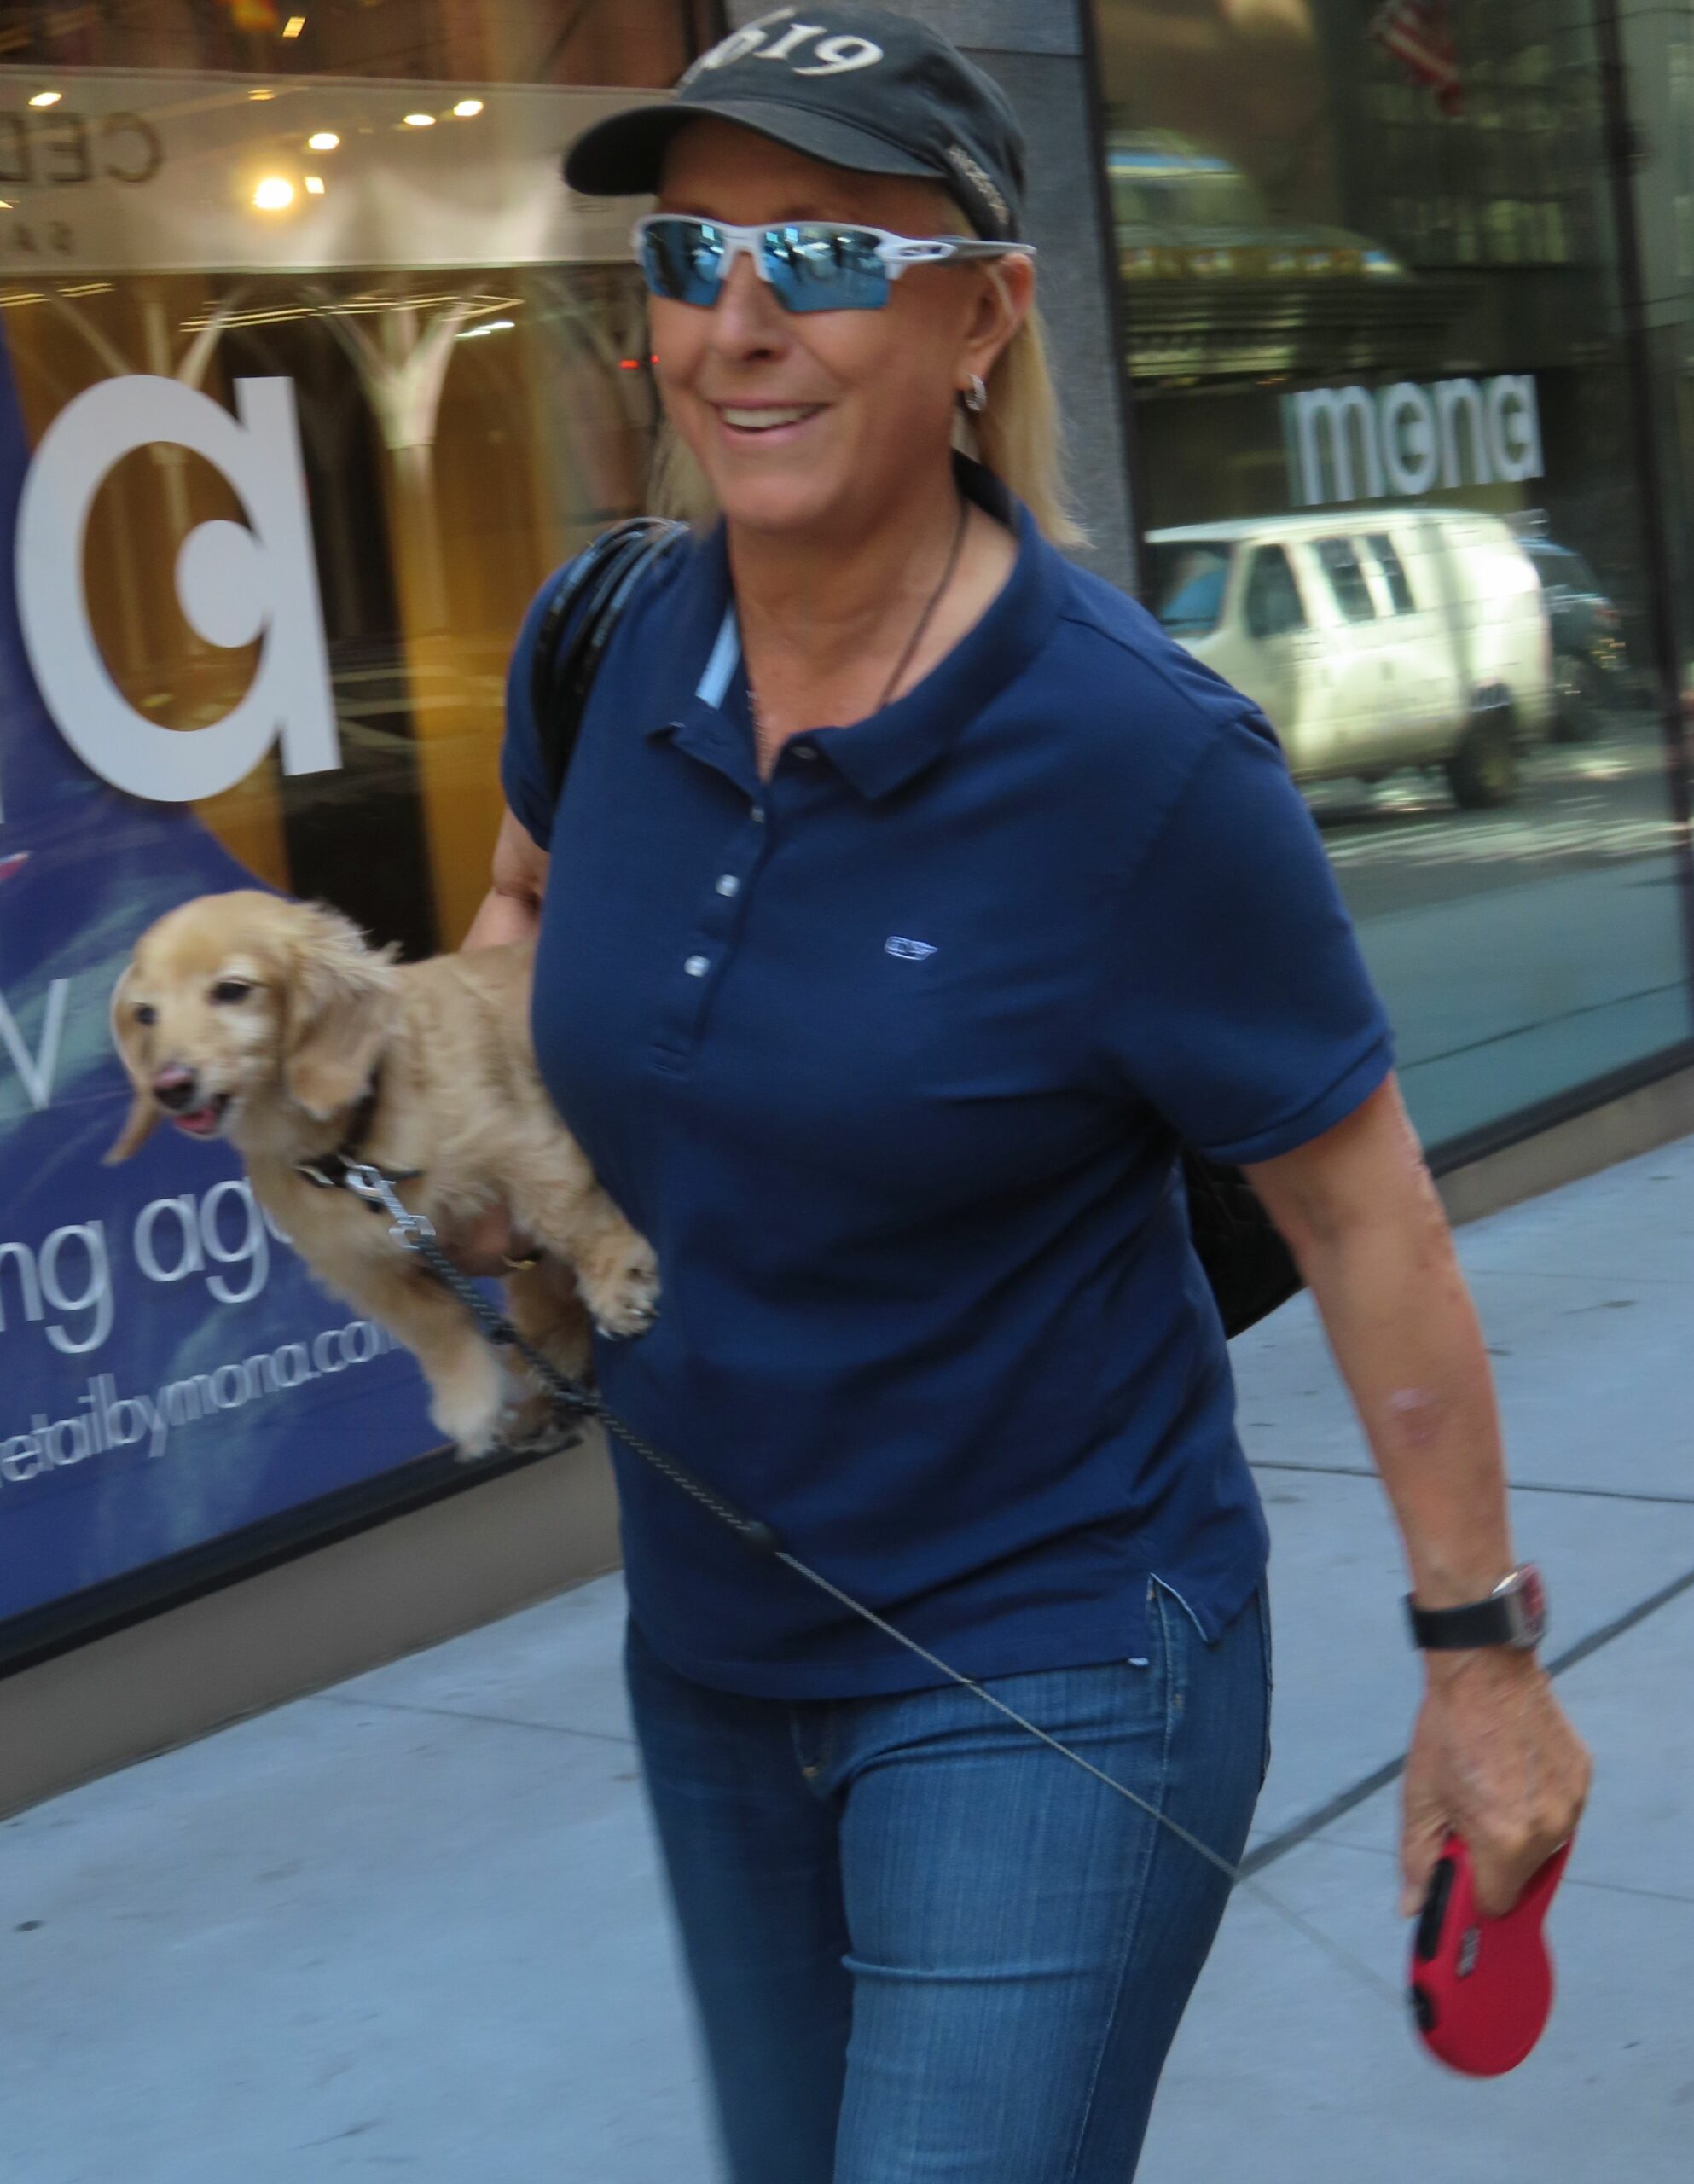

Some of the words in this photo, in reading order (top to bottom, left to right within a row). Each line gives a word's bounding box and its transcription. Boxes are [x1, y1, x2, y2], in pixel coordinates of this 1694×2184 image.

[1288, 375, 1545, 508] mona
[0, 374, 343, 824] a
[133, 1177, 293, 1304] ag
[0, 1320, 403, 1489] etailbymona.co
